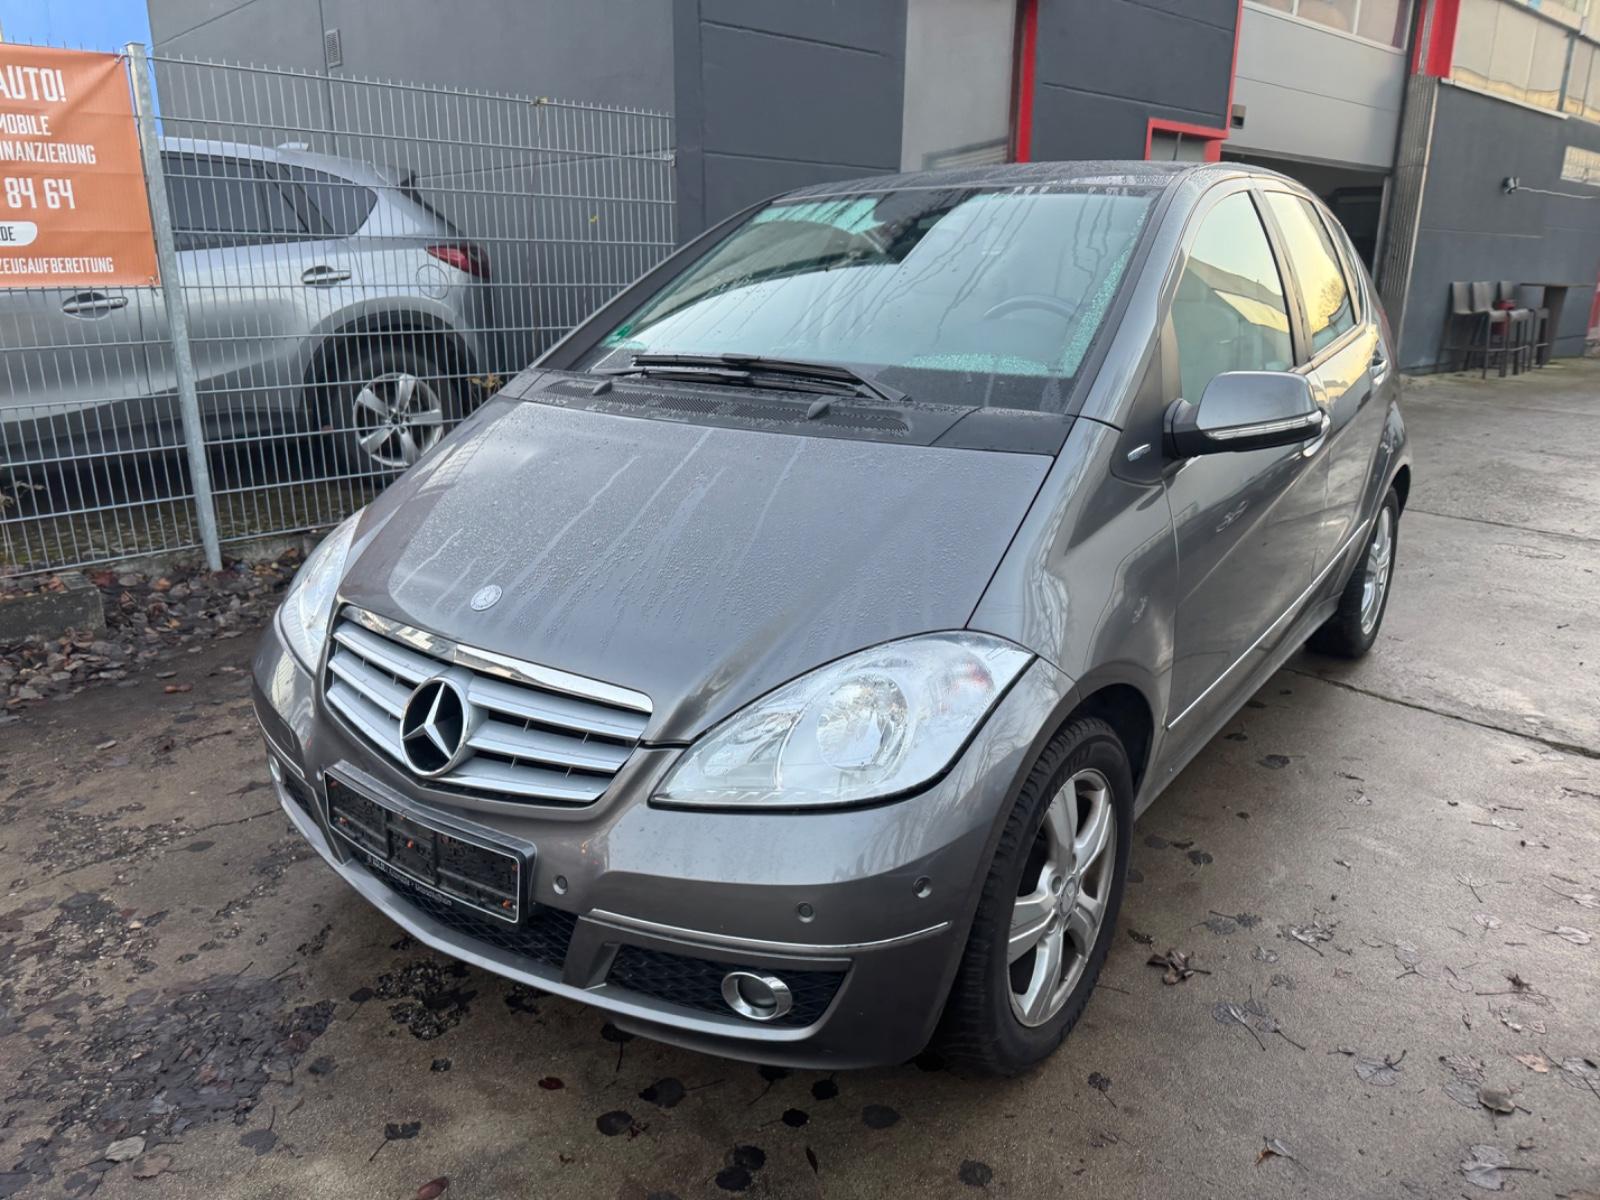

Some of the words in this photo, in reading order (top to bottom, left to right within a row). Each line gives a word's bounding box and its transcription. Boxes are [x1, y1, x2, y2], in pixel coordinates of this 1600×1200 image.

[0, 65, 67, 102] AUTO!
[4, 177, 37, 209] 84
[43, 178, 76, 209] 64
